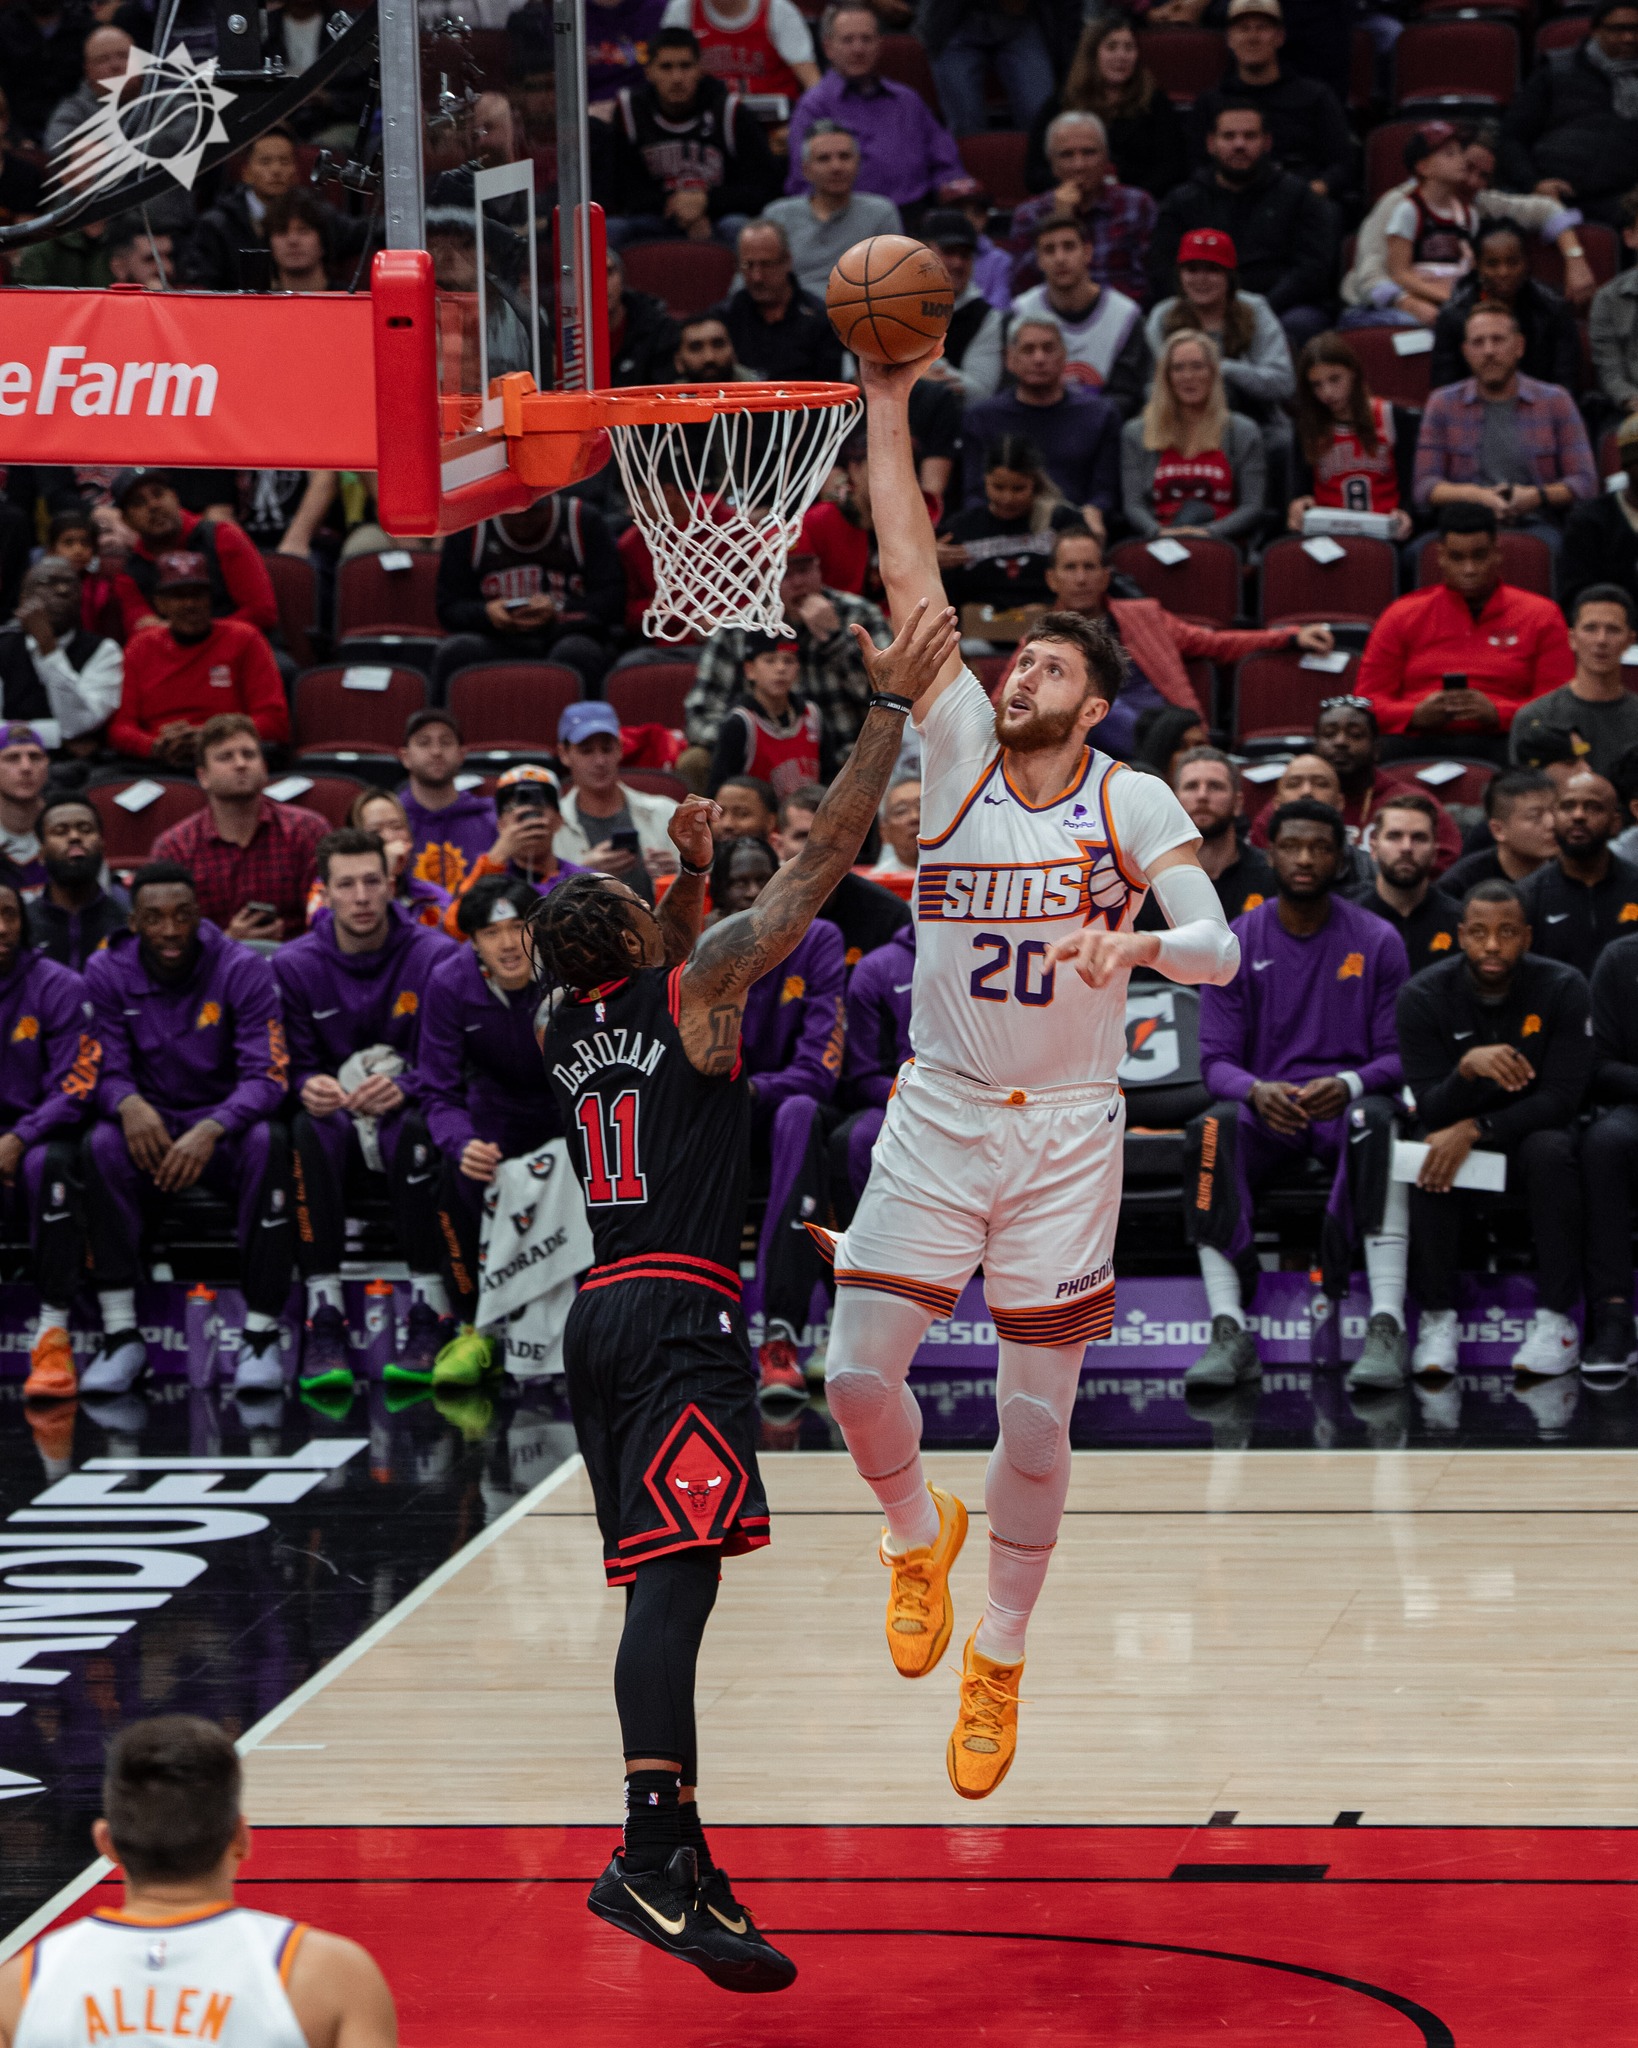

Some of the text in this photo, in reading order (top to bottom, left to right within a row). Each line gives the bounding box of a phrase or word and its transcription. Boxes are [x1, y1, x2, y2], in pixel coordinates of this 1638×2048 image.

[1062, 819, 1096, 830] PayPal
[941, 865, 1083, 919] SUNS
[970, 932, 1056, 1008] 20
[574, 1089, 648, 1207] 11
[478, 1226, 568, 1293] ATORADE
[84, 1986, 234, 2045] ALLEN
